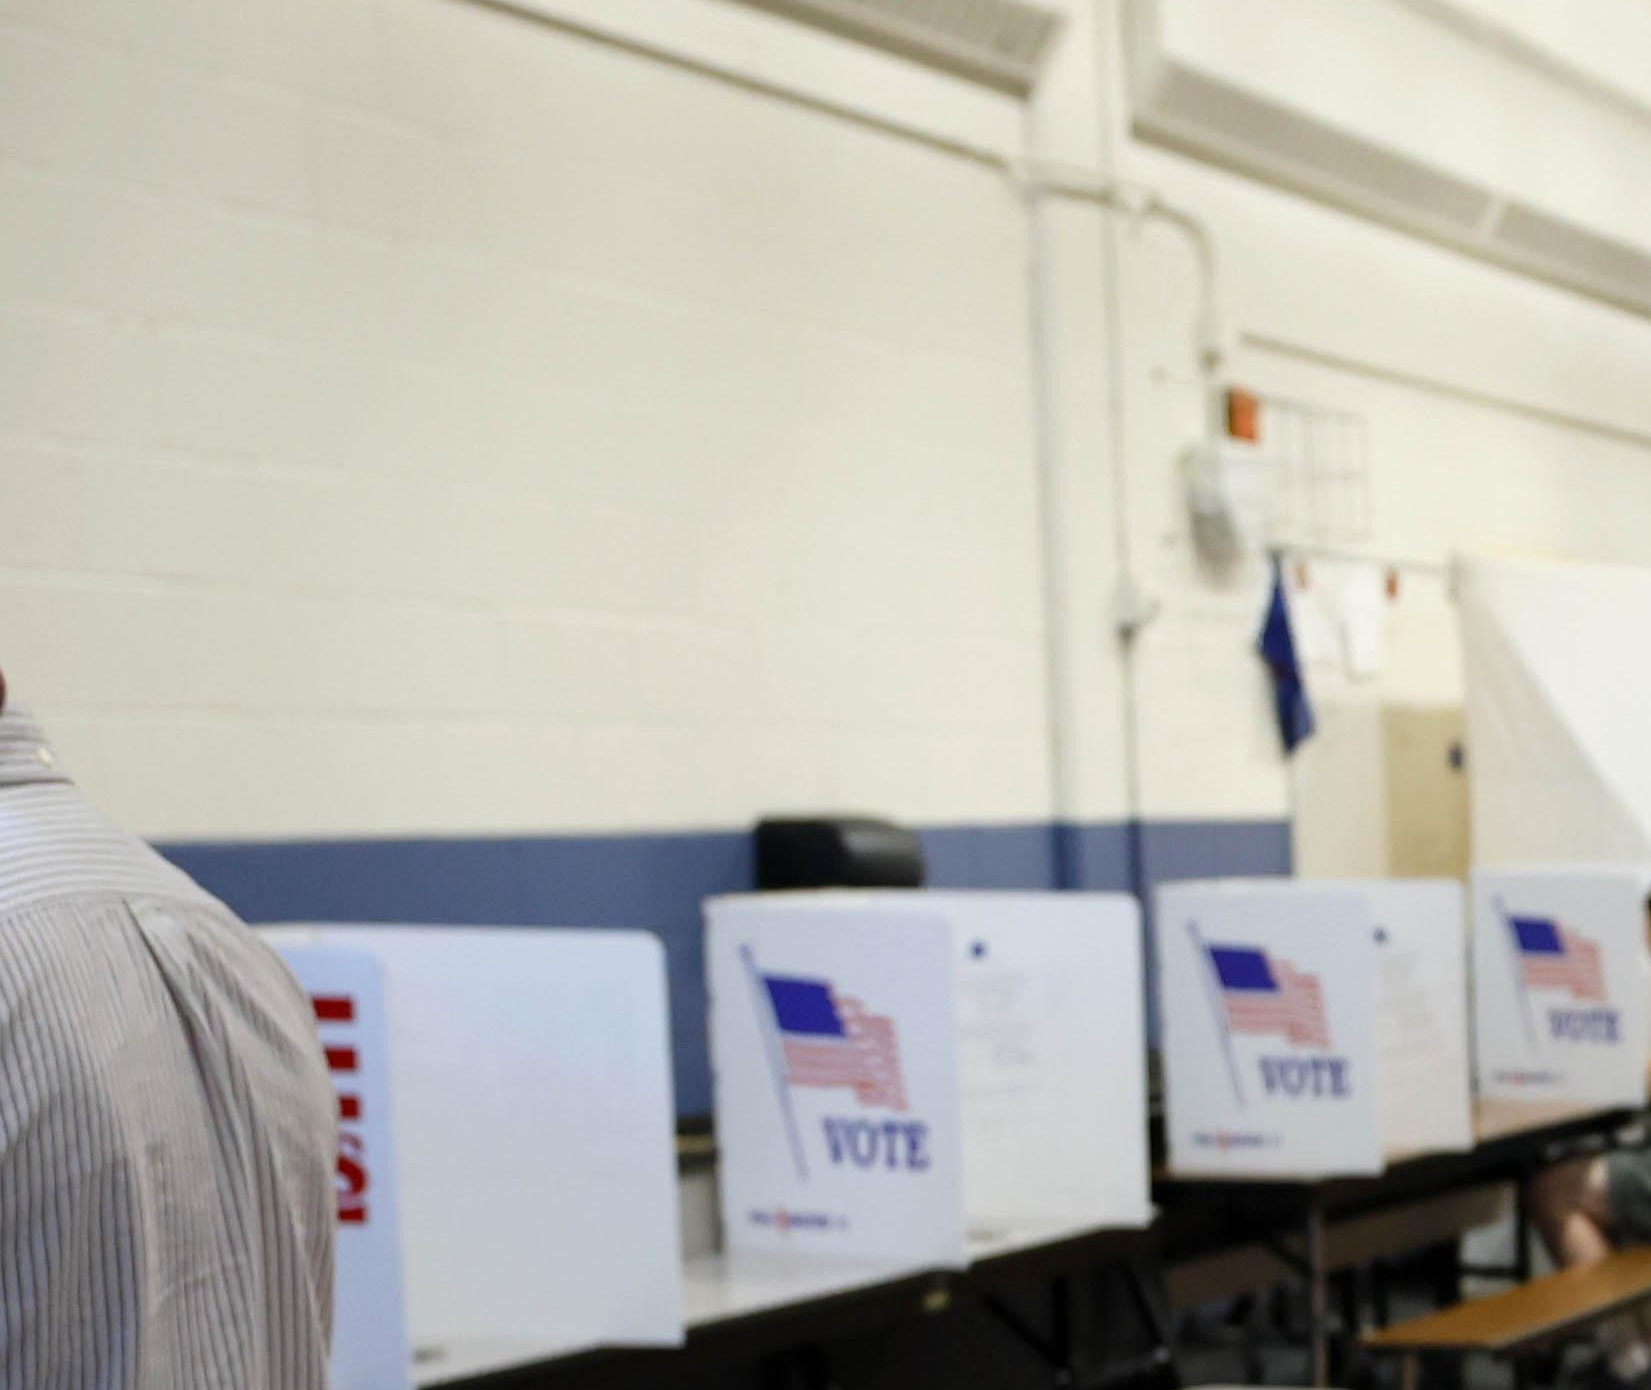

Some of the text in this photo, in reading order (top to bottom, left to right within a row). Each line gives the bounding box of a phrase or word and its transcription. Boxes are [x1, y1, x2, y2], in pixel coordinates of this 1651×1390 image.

[1548, 1008, 1621, 1043] VOTE
[1258, 1055, 1351, 1098] VOTE
[821, 1115, 931, 1173] VOTE
